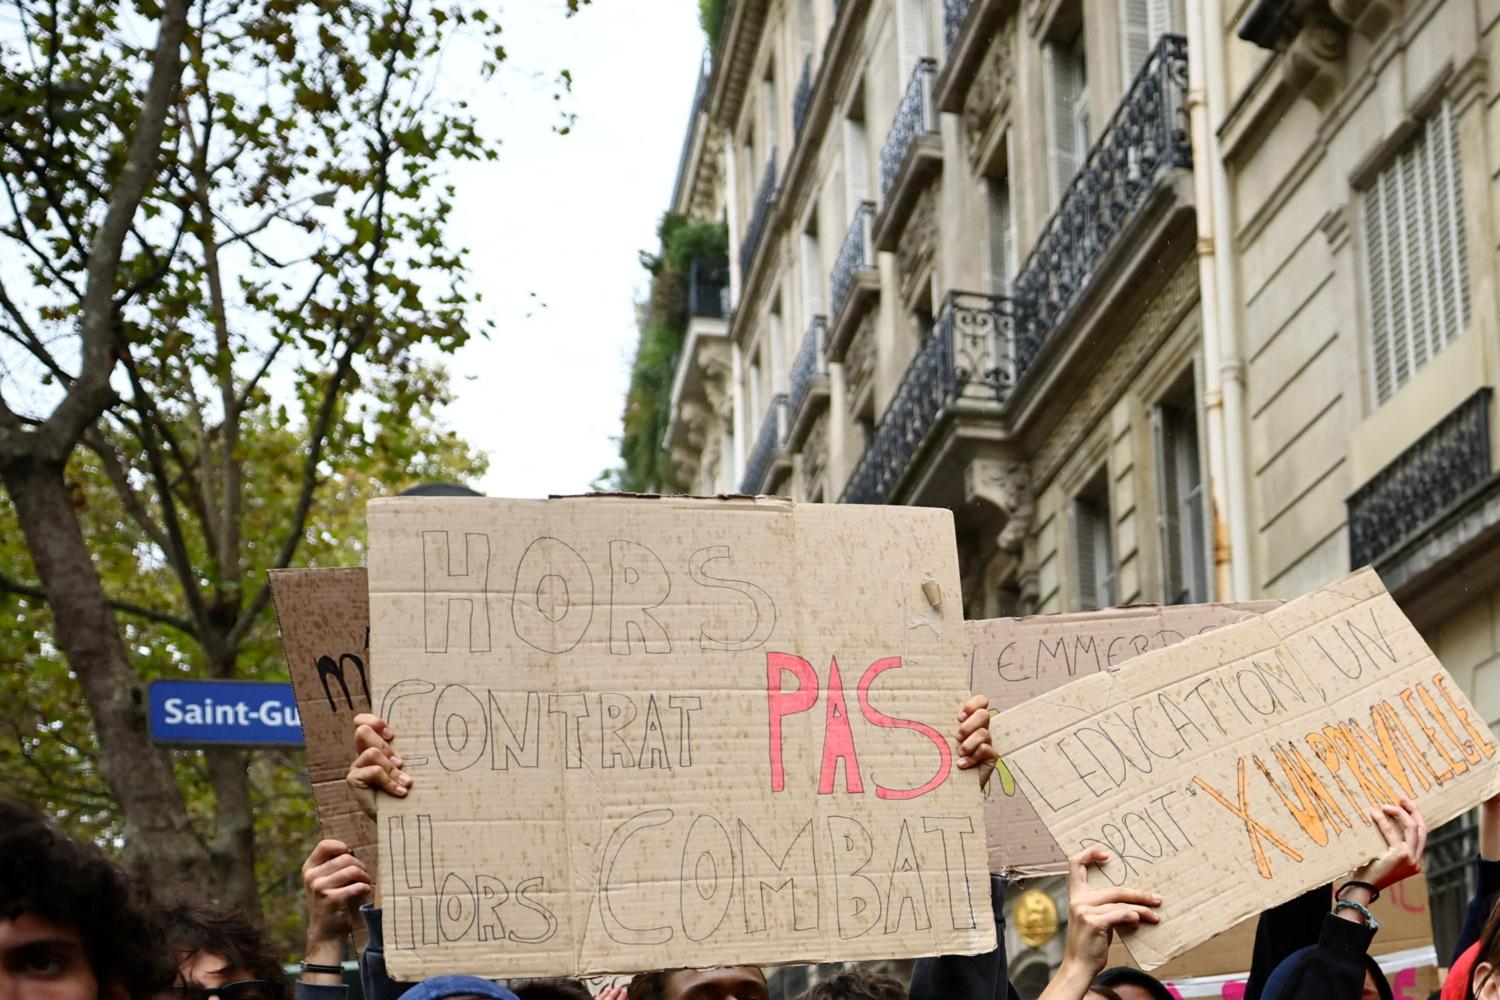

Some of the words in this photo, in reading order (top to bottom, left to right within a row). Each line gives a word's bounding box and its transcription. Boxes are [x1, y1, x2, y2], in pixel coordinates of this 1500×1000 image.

[422, 530, 777, 655] HORS
[997, 625, 1217, 682] EMMER
[1311, 607, 1398, 680] UN
[164, 698, 301, 727] Saint-Gu
[380, 679, 703, 772] CONTRAT
[766, 651, 952, 800] PAS
[1079, 790, 1194, 887] DROIT
[1192, 755, 1304, 880] X
[1252, 740, 1353, 848] UN
[388, 814, 558, 950] HORS
[598, 808, 977, 945] COMBAT
